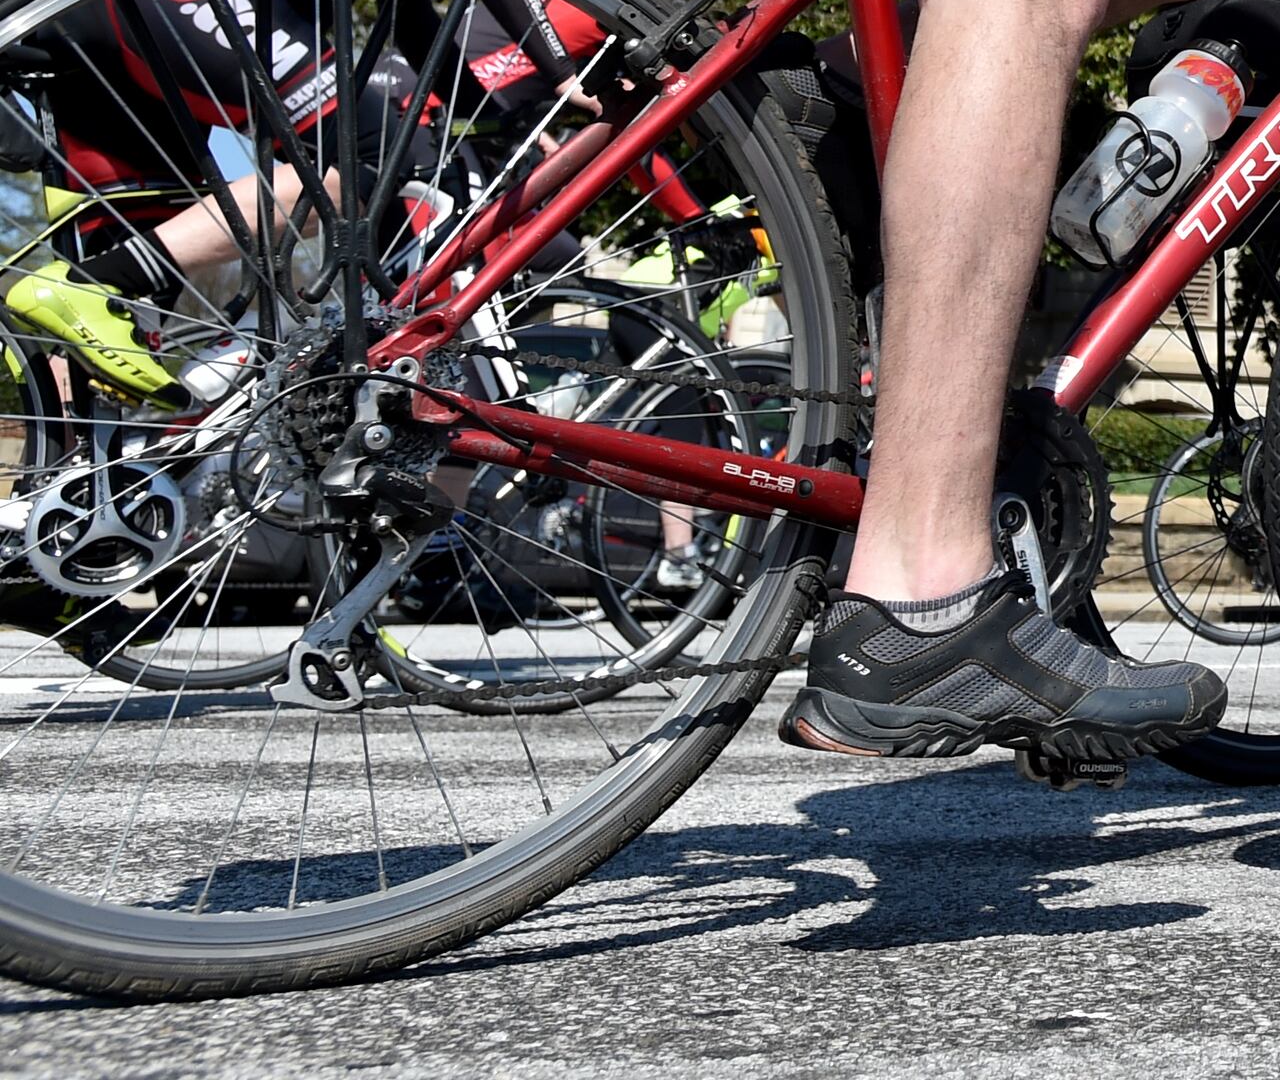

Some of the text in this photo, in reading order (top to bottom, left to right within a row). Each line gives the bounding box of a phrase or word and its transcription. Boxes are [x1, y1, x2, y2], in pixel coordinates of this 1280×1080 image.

[1016, 549, 1033, 584] SHIM
[837, 652, 871, 677] MT33
[1079, 762, 1125, 773] SHIMANO
